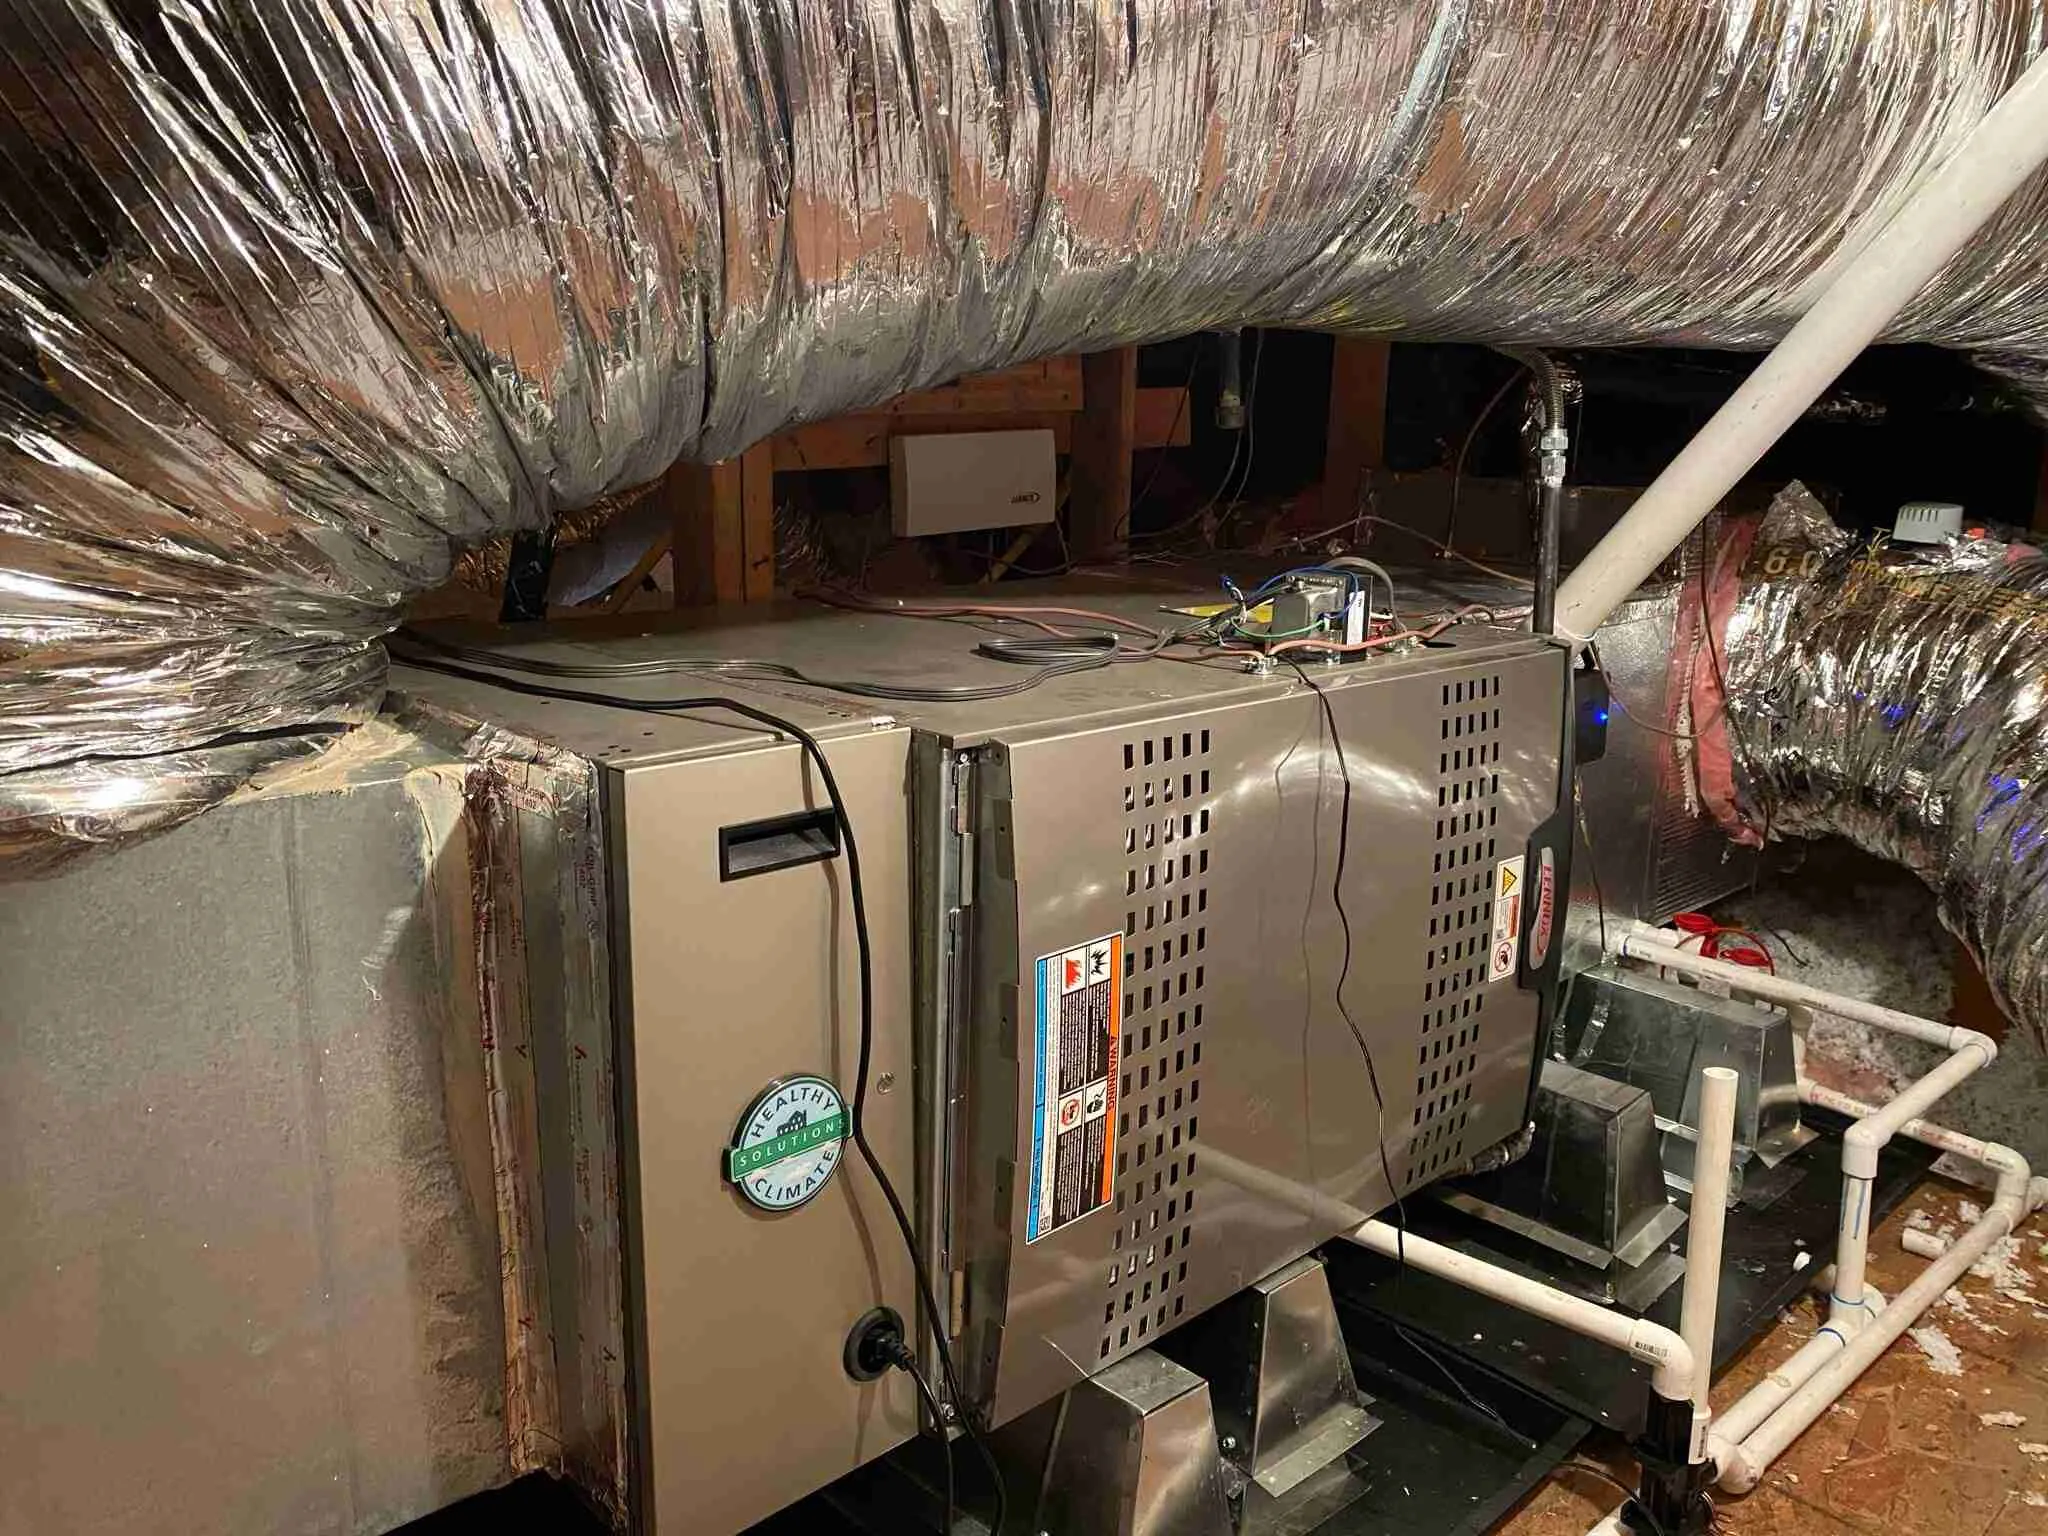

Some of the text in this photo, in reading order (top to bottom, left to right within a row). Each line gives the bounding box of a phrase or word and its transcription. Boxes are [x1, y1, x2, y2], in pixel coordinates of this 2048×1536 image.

[1542, 866, 1552, 936] LENNOX
[1107, 1047, 1117, 1112] WARNING
[751, 1087, 835, 1138] HEALTHY
[739, 1117, 844, 1167] SOLUTIONS
[754, 1150, 836, 1201] CLIMATE
